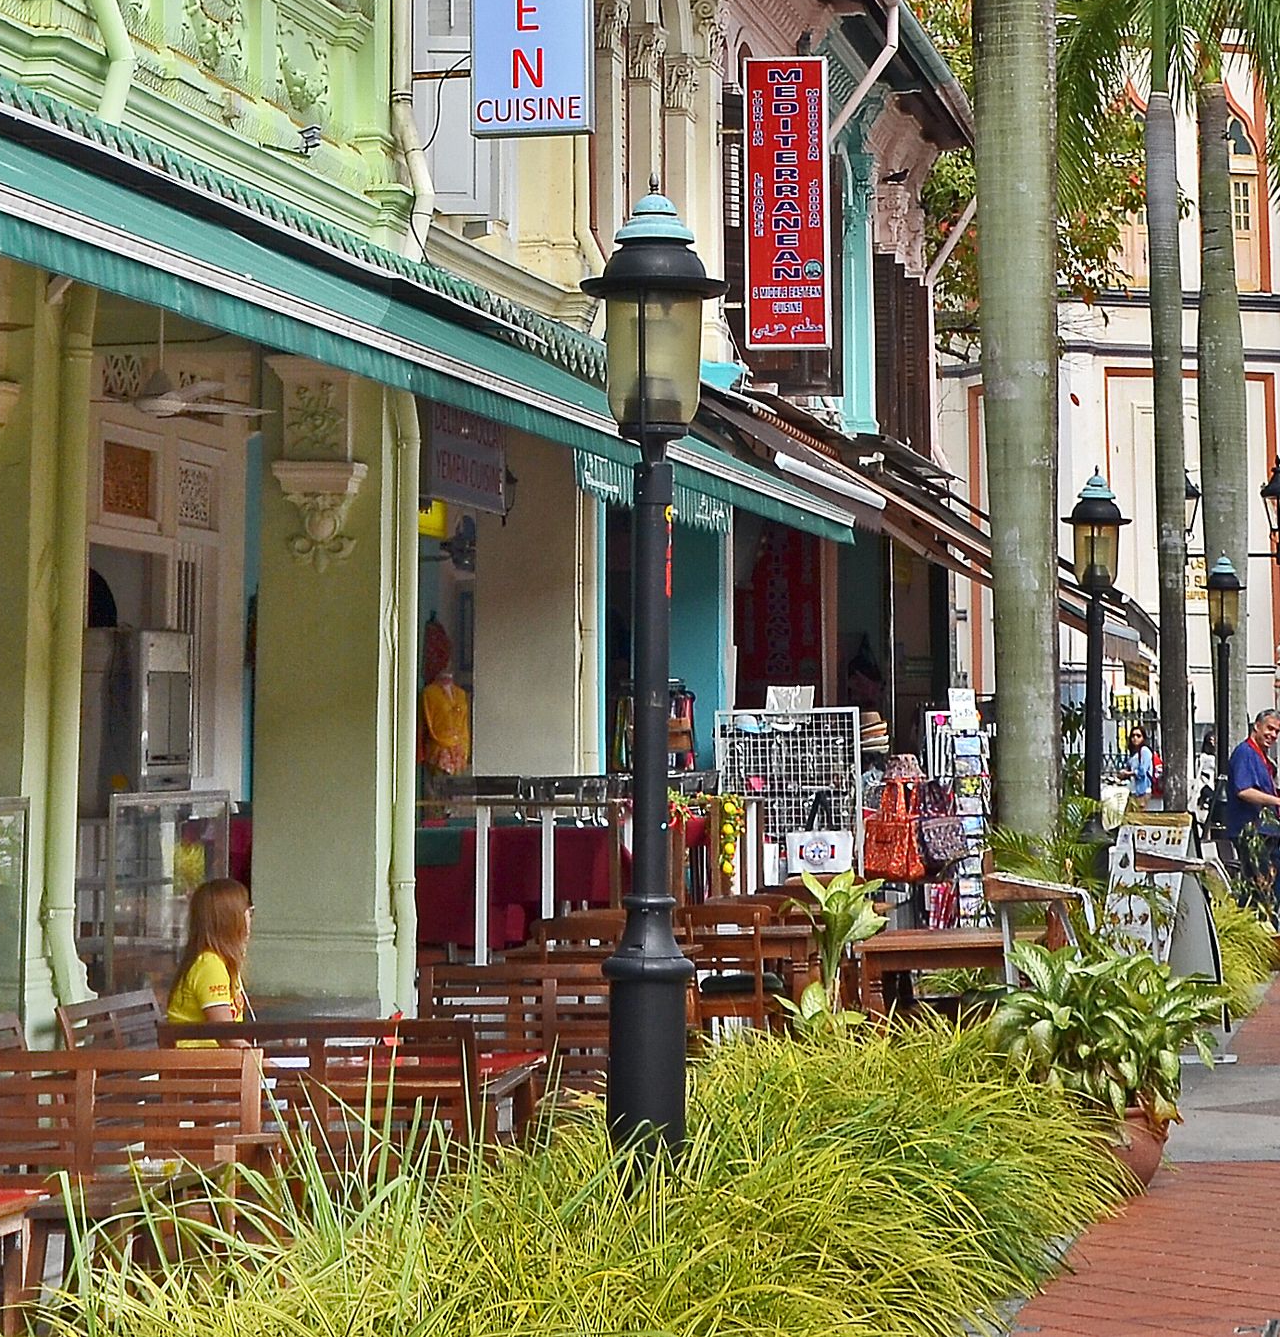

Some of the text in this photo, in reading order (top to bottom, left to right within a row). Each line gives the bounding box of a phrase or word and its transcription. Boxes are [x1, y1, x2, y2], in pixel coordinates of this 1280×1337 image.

[476, 95, 582, 124] CUISINE
[767, 68, 803, 281] MEDITERRANEAN
[760, 286, 788, 299] MIDDLE
[788, 285, 822, 298] EASTERN
[772, 301, 803, 314] CUISINE
